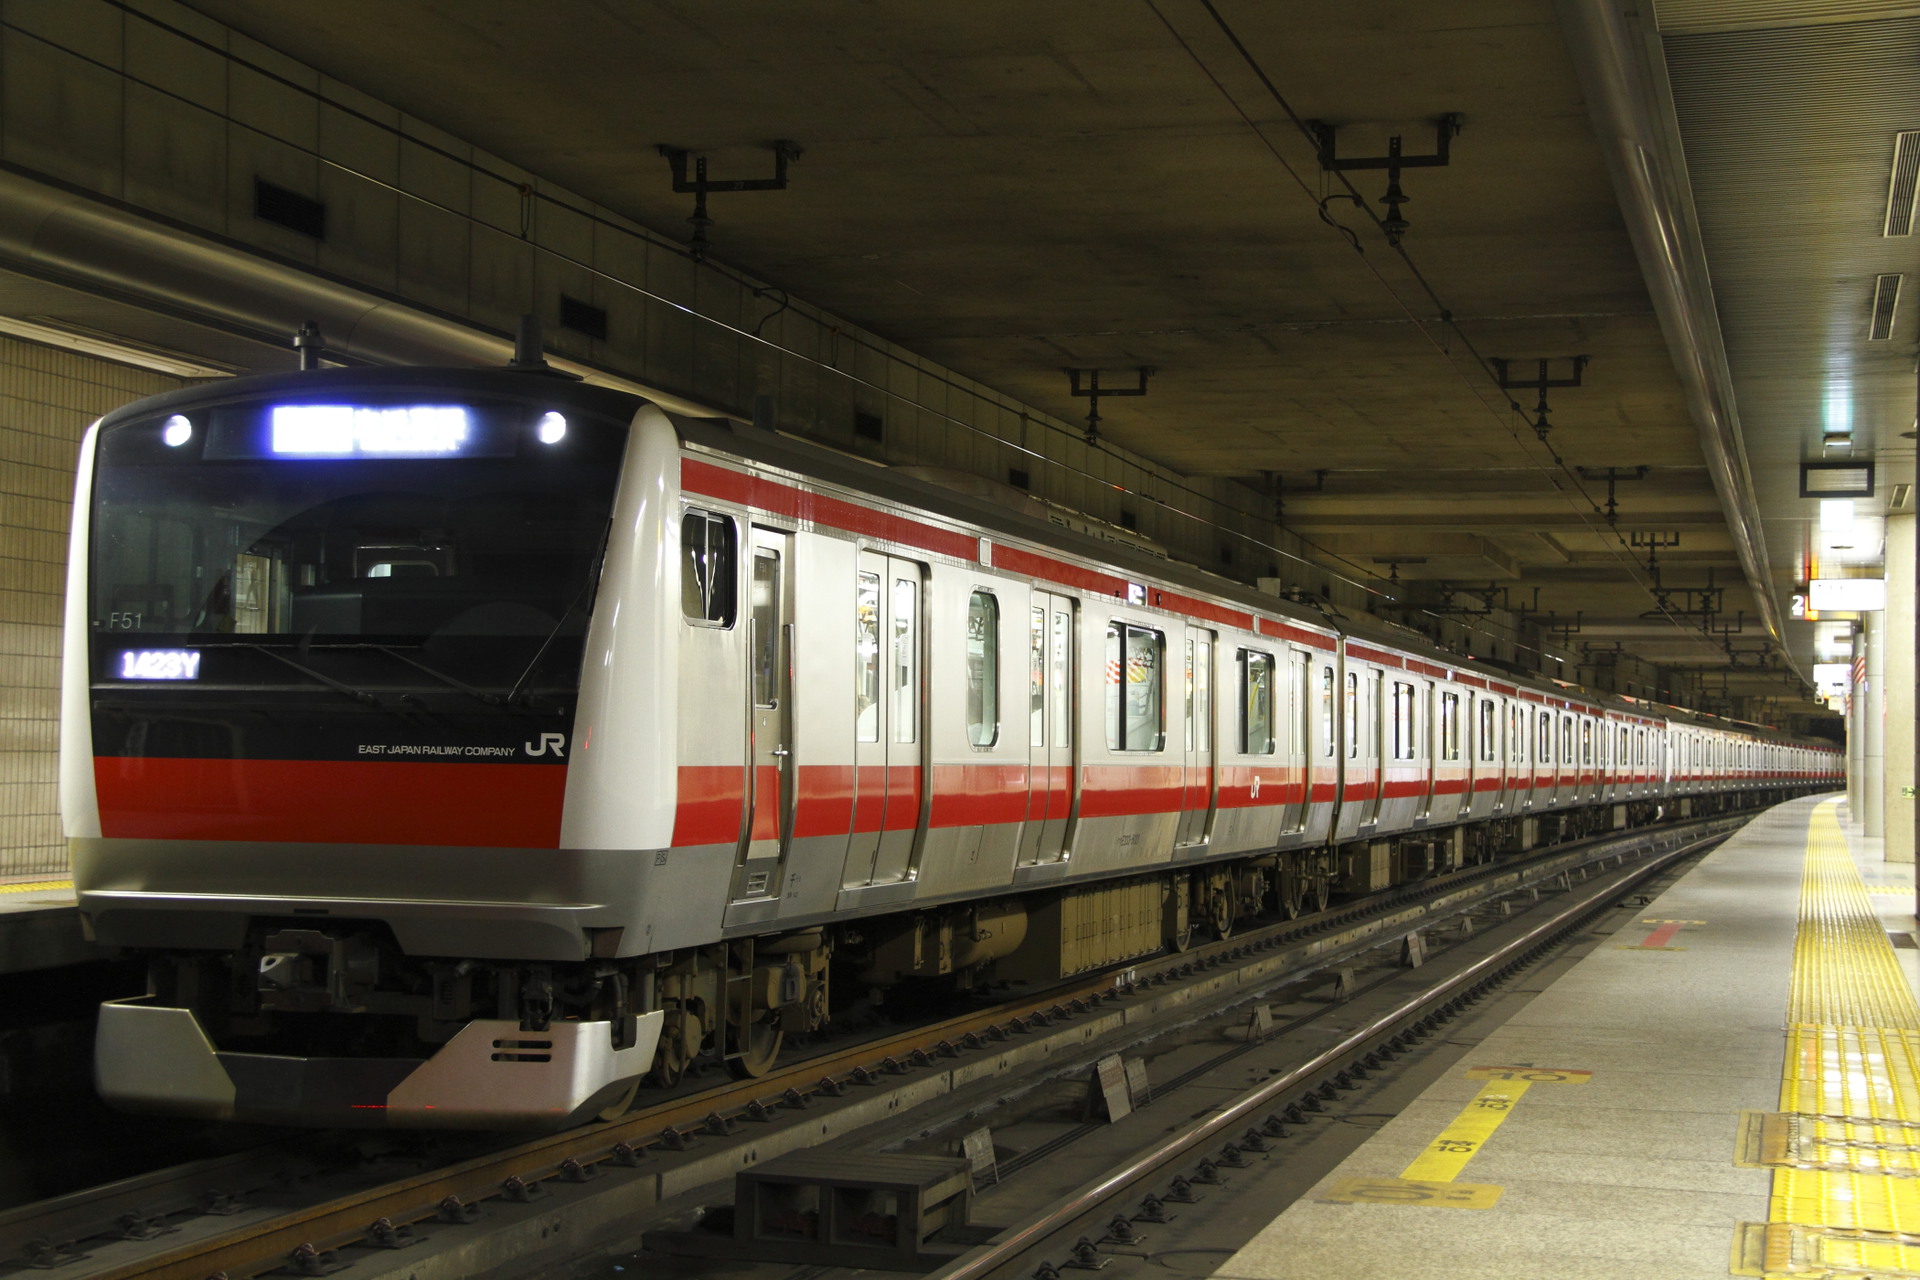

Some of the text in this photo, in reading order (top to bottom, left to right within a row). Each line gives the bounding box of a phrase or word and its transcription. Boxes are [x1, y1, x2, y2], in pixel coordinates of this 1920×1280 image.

[1791, 594, 1805, 611] 2
[110, 611, 142, 629] F51
[358, 744, 516, 757] EAST JAPAN RAILWAY COMPANY
[525, 733, 566, 757] JR
[1250, 775, 1261, 799] JR
[1487, 1072, 1567, 1082] 10
[1433, 1145, 1473, 1153] 10
